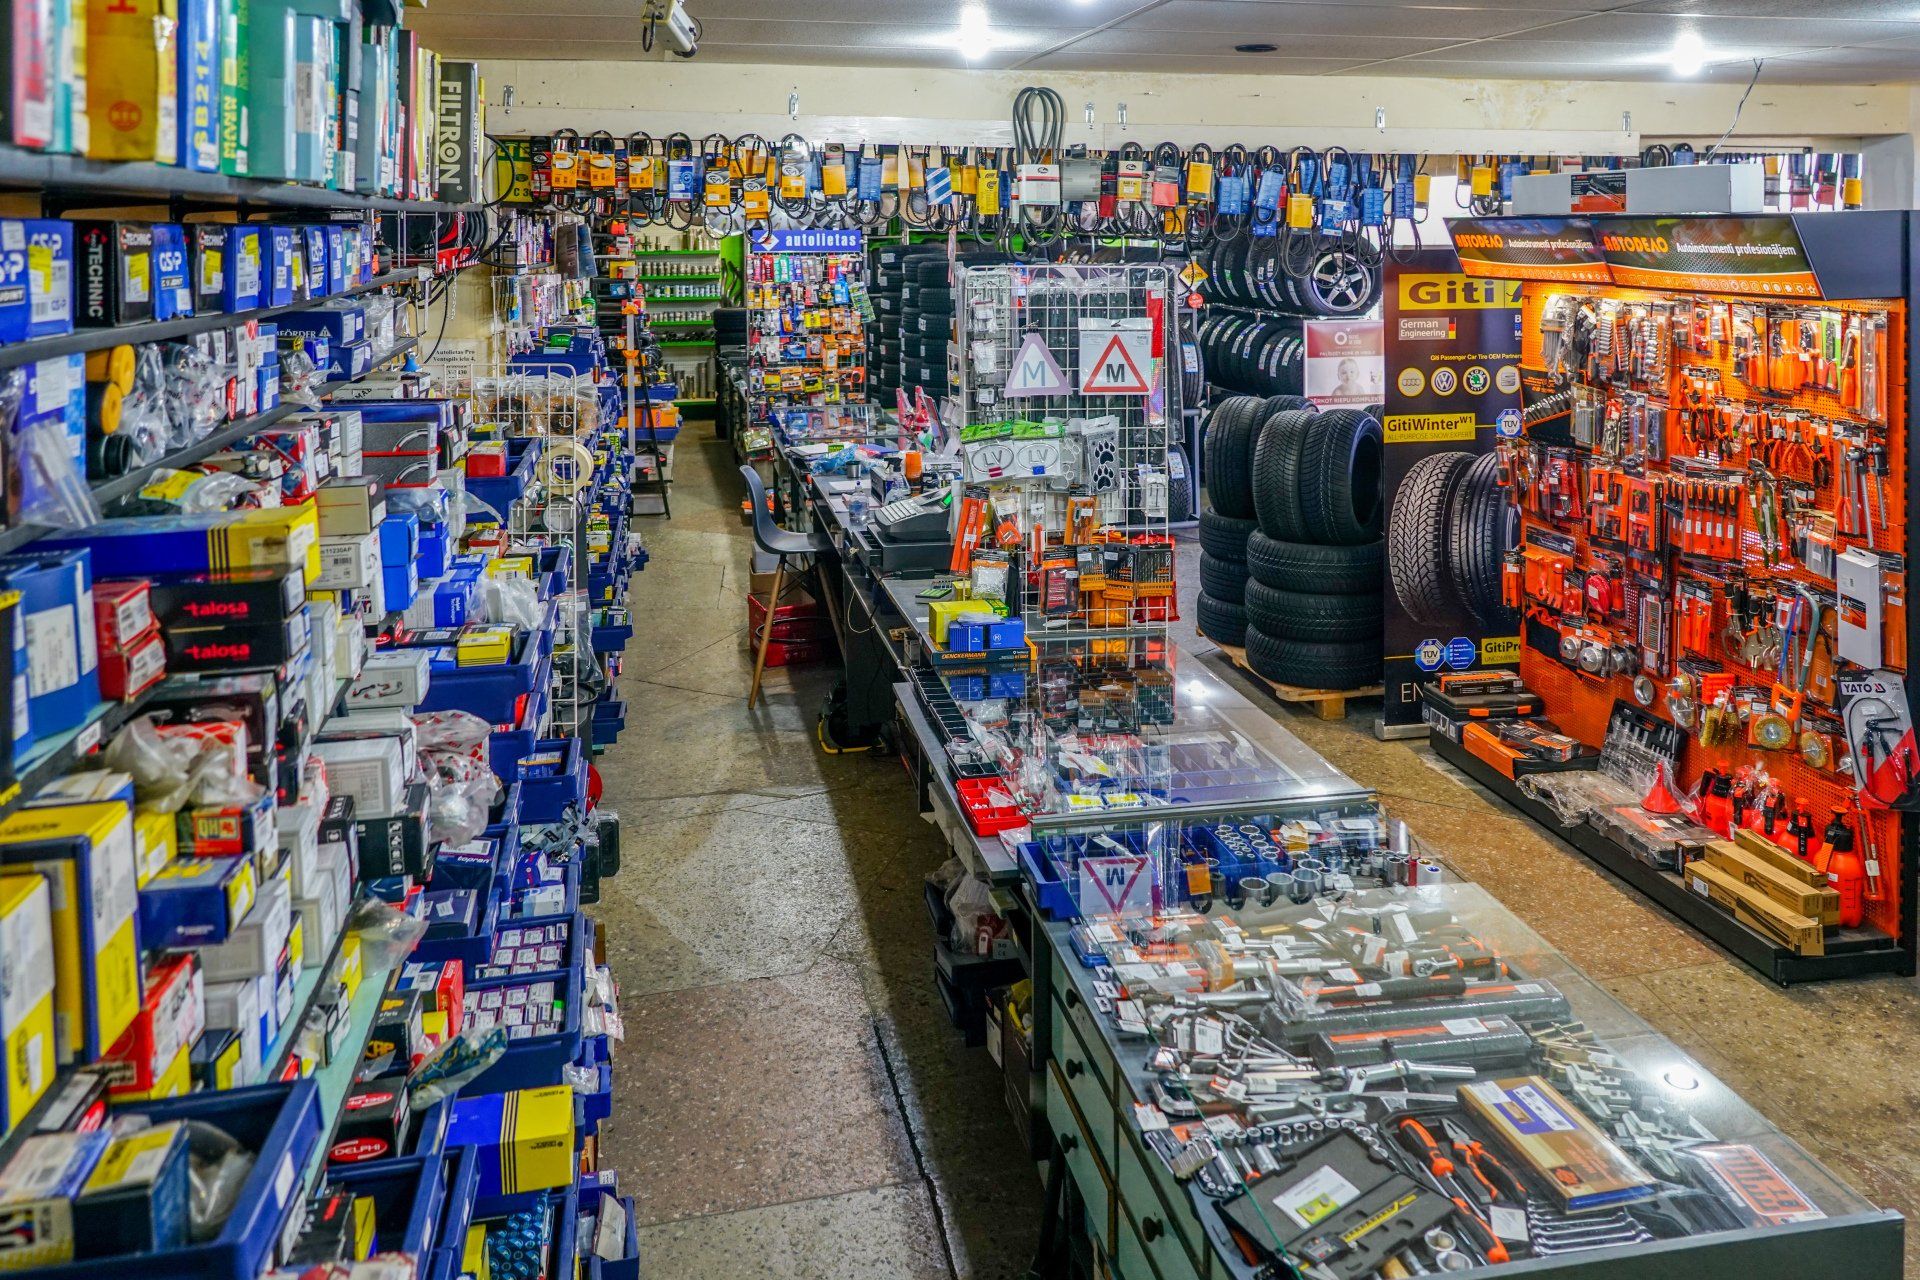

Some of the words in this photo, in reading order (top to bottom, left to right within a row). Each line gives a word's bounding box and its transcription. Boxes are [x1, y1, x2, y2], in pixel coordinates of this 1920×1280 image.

[440, 81, 462, 184] FILTRON
[785, 235, 857, 247] autolietas
[1676, 242, 1735, 254] Autoinstrumenti
[88, 244, 104, 318] TECHNIC
[1409, 280, 1495, 304] Giti
[1400, 319, 1439, 329] German
[1400, 329, 1446, 339] Engineering
[1441, 354, 1466, 362] Passenger
[1022, 361, 1046, 387] M
[1105, 364, 1126, 383] M
[1387, 418, 1460, 432] GitiWinter
[1387, 432, 1429, 440] ALL-PURPOSE
[1430, 432, 1449, 440] SNOW
[1450, 431, 1472, 439] EXPERT
[983, 447, 1002, 466] LV
[1029, 449, 1049, 464] LV
[185, 600, 249, 617] talosa
[185, 644, 250, 661] talosa
[1843, 683, 1873, 693] YATO
[456, 855, 491, 865] topran
[334, 1144, 381, 1155] DELPHI
